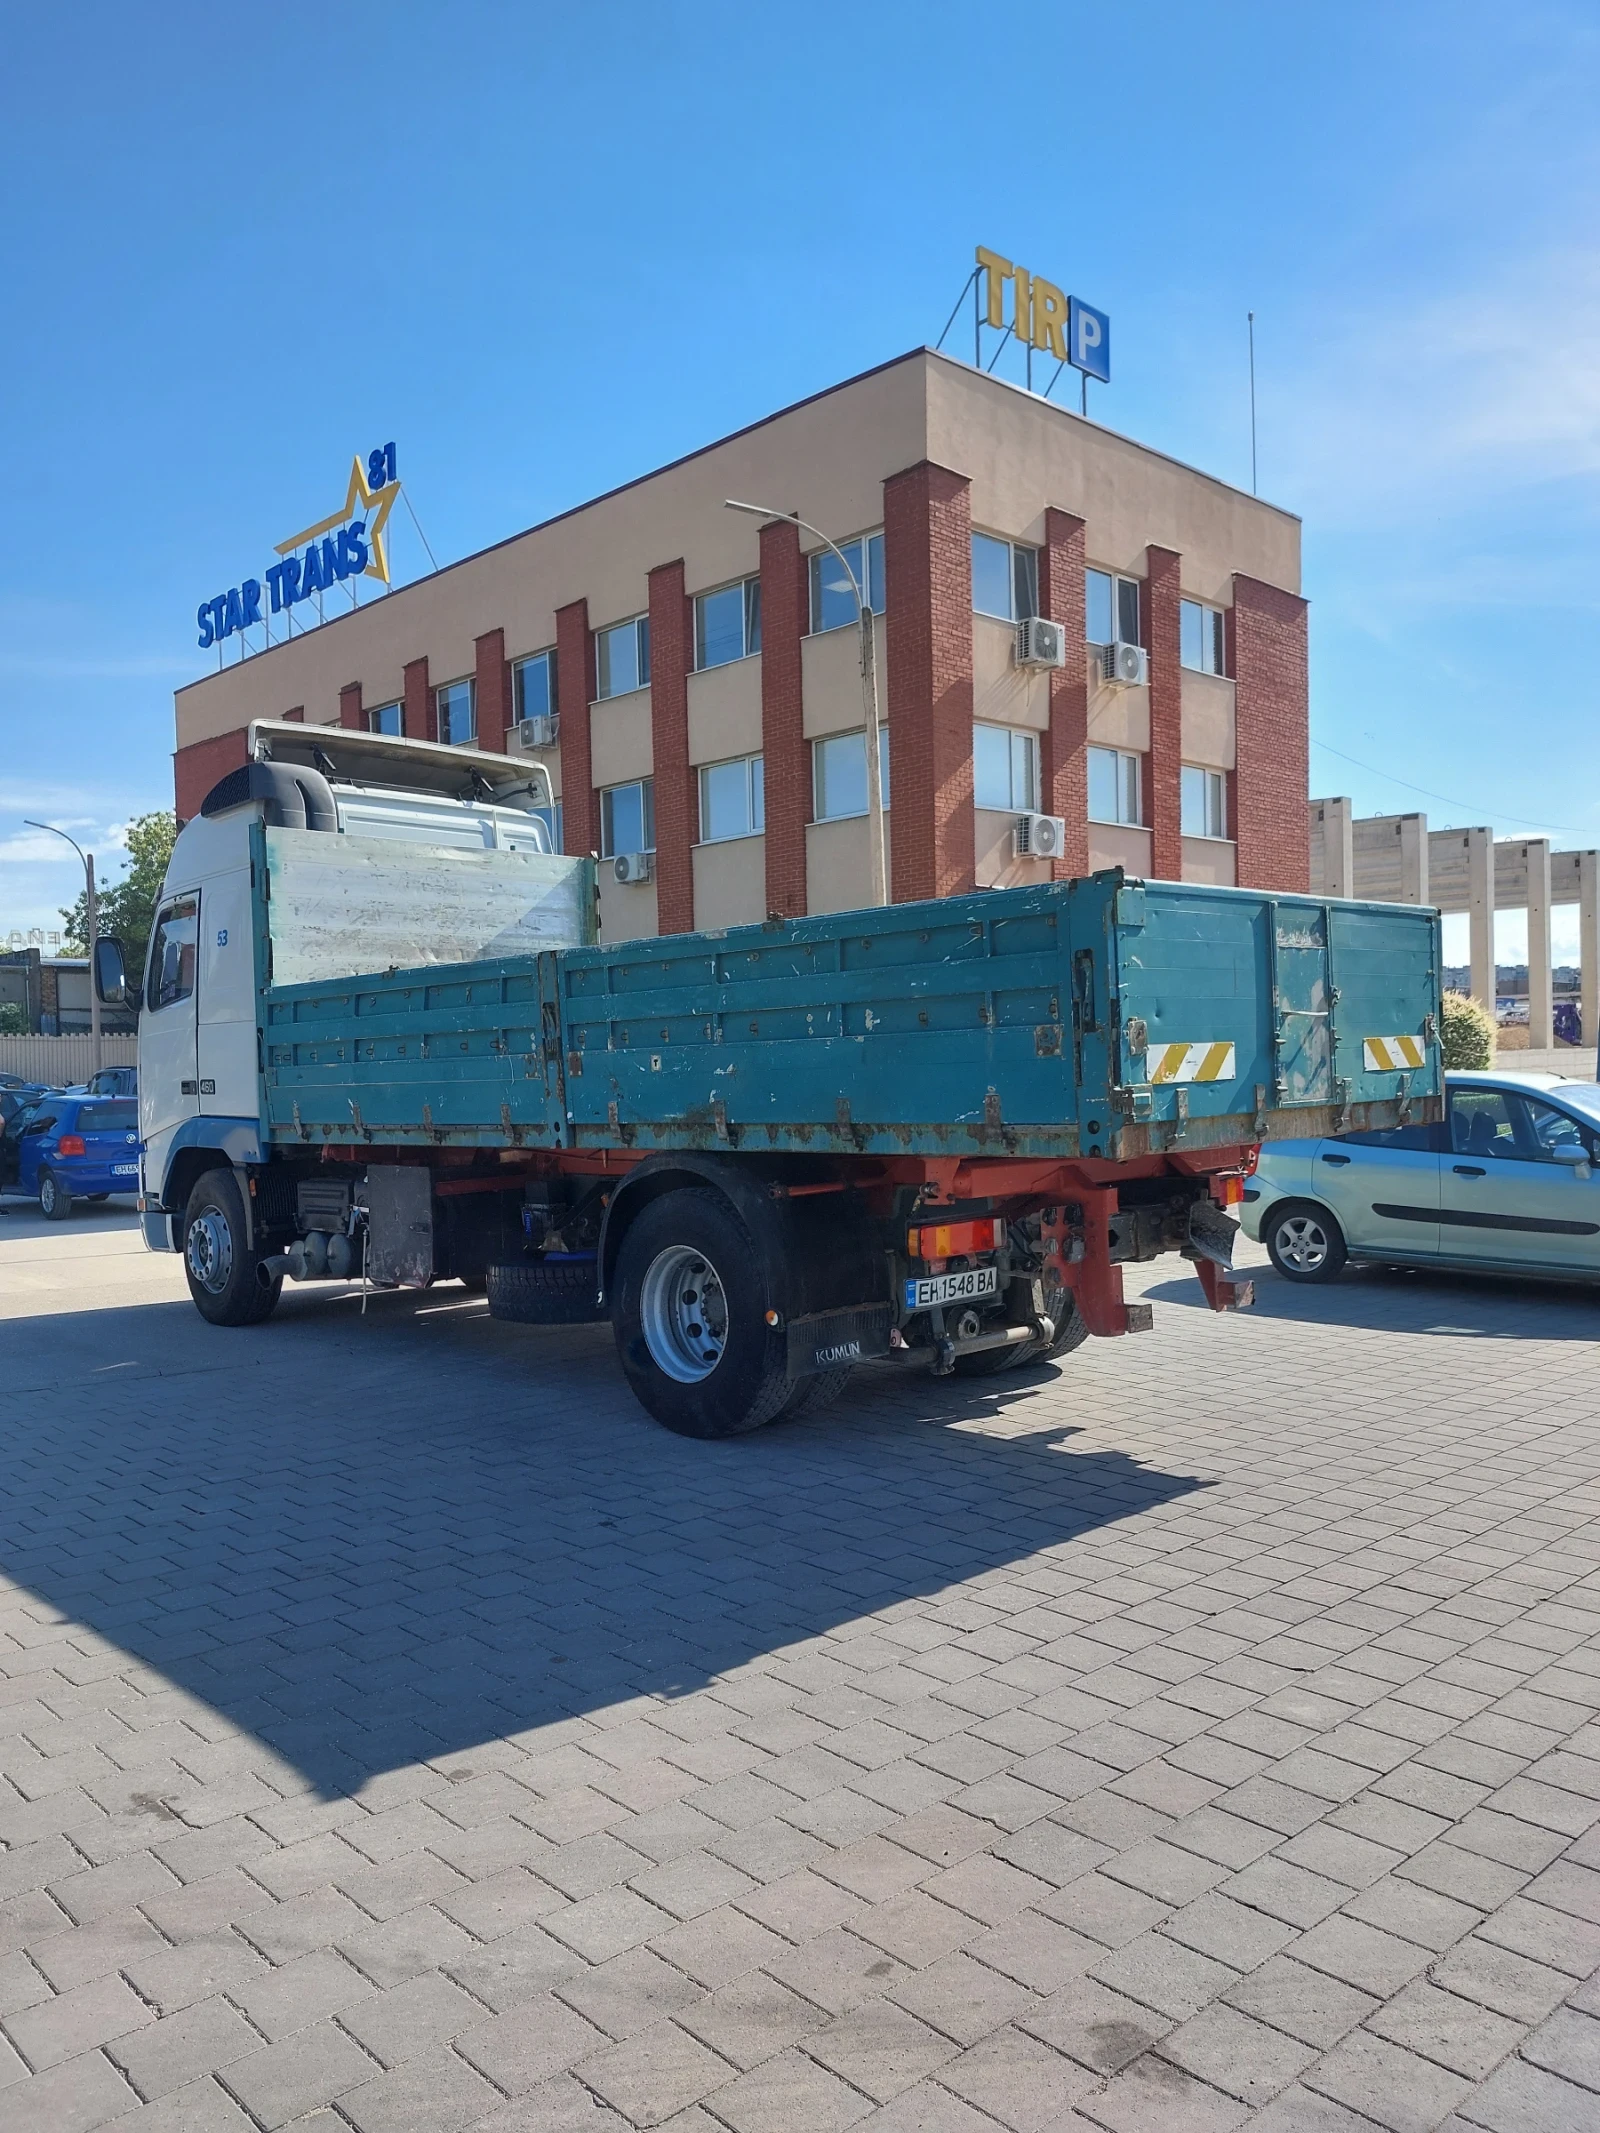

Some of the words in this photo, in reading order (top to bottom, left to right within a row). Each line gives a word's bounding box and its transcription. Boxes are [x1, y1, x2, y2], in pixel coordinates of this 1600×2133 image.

[975, 245, 1068, 362] TIR
[1078, 309, 1102, 361] P
[368, 441, 397, 490] 81
[197, 578, 263, 649] STAR
[266, 521, 369, 614] TRANS
[217, 929, 228, 947] 53
[942, 1274, 974, 1299] 1548
[815, 1341, 860, 1364] KUMLIN
